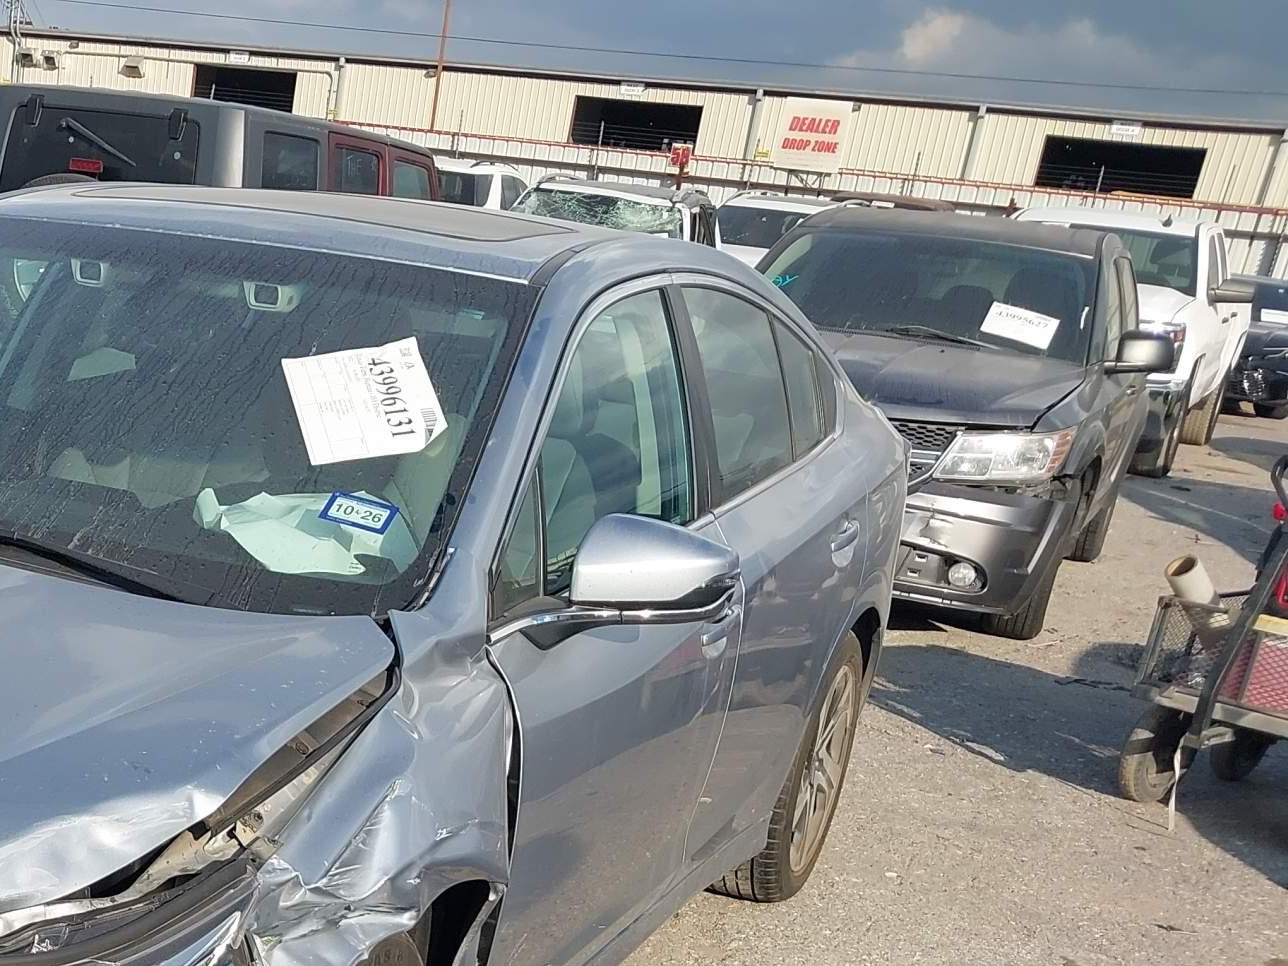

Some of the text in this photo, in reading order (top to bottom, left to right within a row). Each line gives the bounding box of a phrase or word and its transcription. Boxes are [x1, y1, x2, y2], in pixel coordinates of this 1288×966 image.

[788, 115, 841, 135] DEALER
[781, 137, 839, 154] DROP ZONE
[368, 357, 416, 438] 43996131
